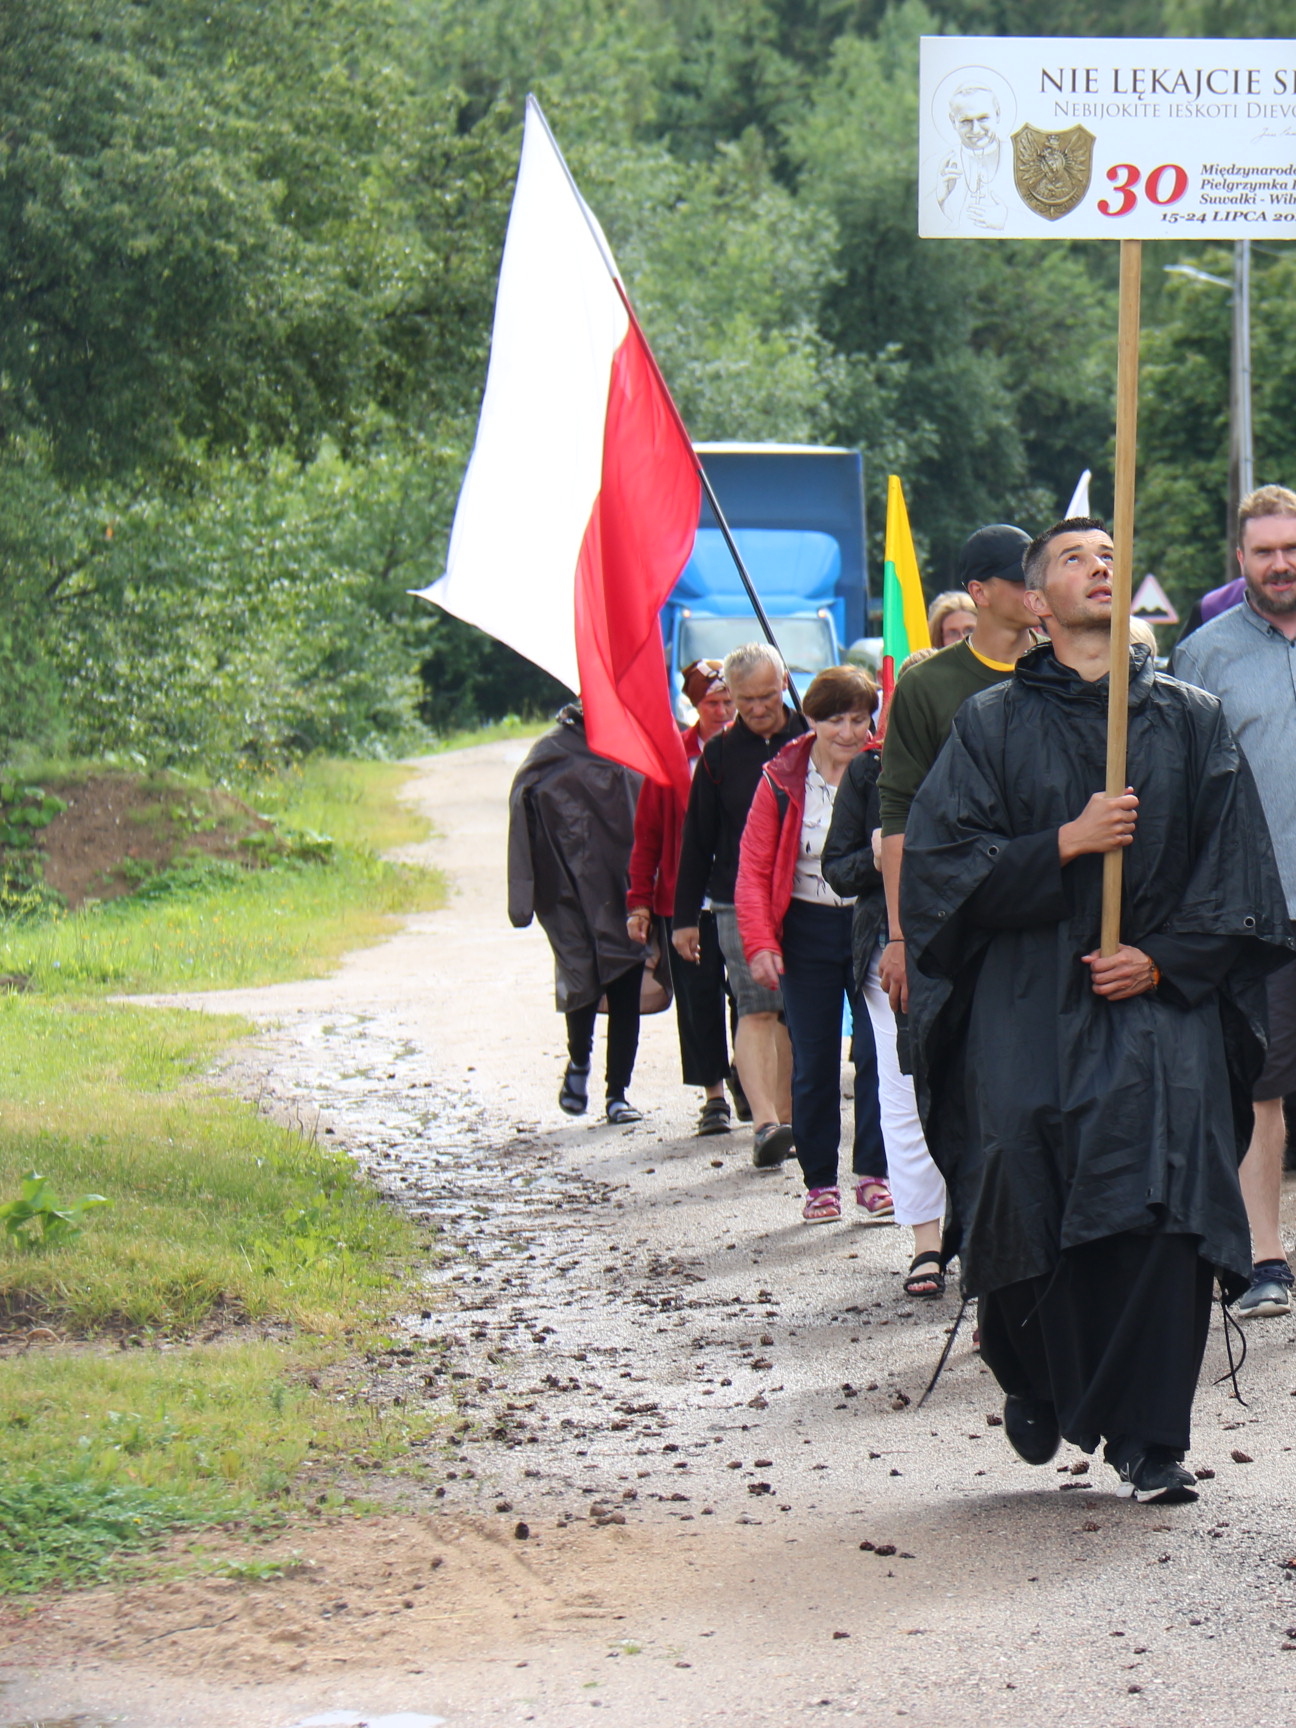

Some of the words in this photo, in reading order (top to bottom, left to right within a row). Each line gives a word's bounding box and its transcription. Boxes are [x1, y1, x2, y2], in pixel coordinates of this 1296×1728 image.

[1040, 67, 1099, 93] NIE
[1112, 68, 1261, 101] LĘKAJCIE
[1054, 101, 1160, 120] NEBIJOKITE
[1097, 163, 1189, 217] 30
[1200, 179, 1288, 192] Pielgrzymka
[1161, 212, 1207, 223] 15-24
[1212, 211, 1268, 222] LIPCA
